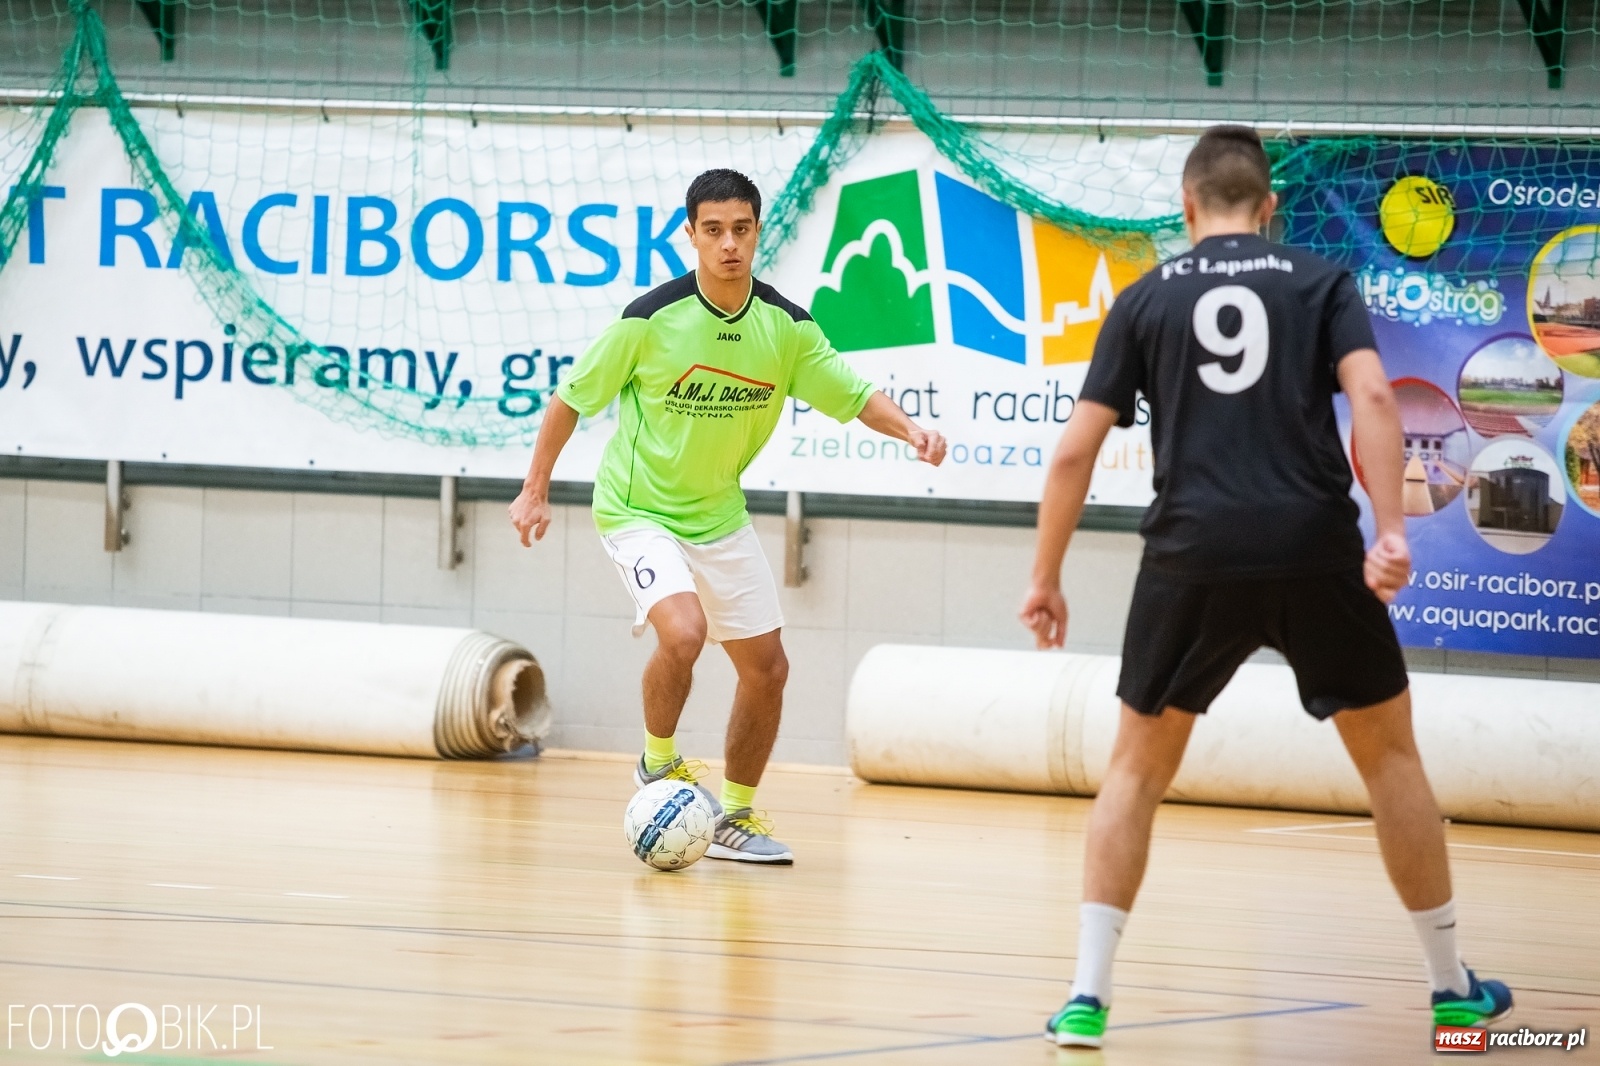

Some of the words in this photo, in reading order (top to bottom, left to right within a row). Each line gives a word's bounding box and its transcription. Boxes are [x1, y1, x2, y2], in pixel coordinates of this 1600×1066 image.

[1162, 257, 1193, 280] FC
[716, 332, 742, 342] JAKO
[1192, 284, 1269, 394] 9
[76, 323, 473, 410] wspieramy,
[667, 382, 716, 402] A.M.J.
[665, 406, 734, 419] SYRYNIA
[951, 442, 1043, 468] oaza
[633, 555, 656, 590] 6
